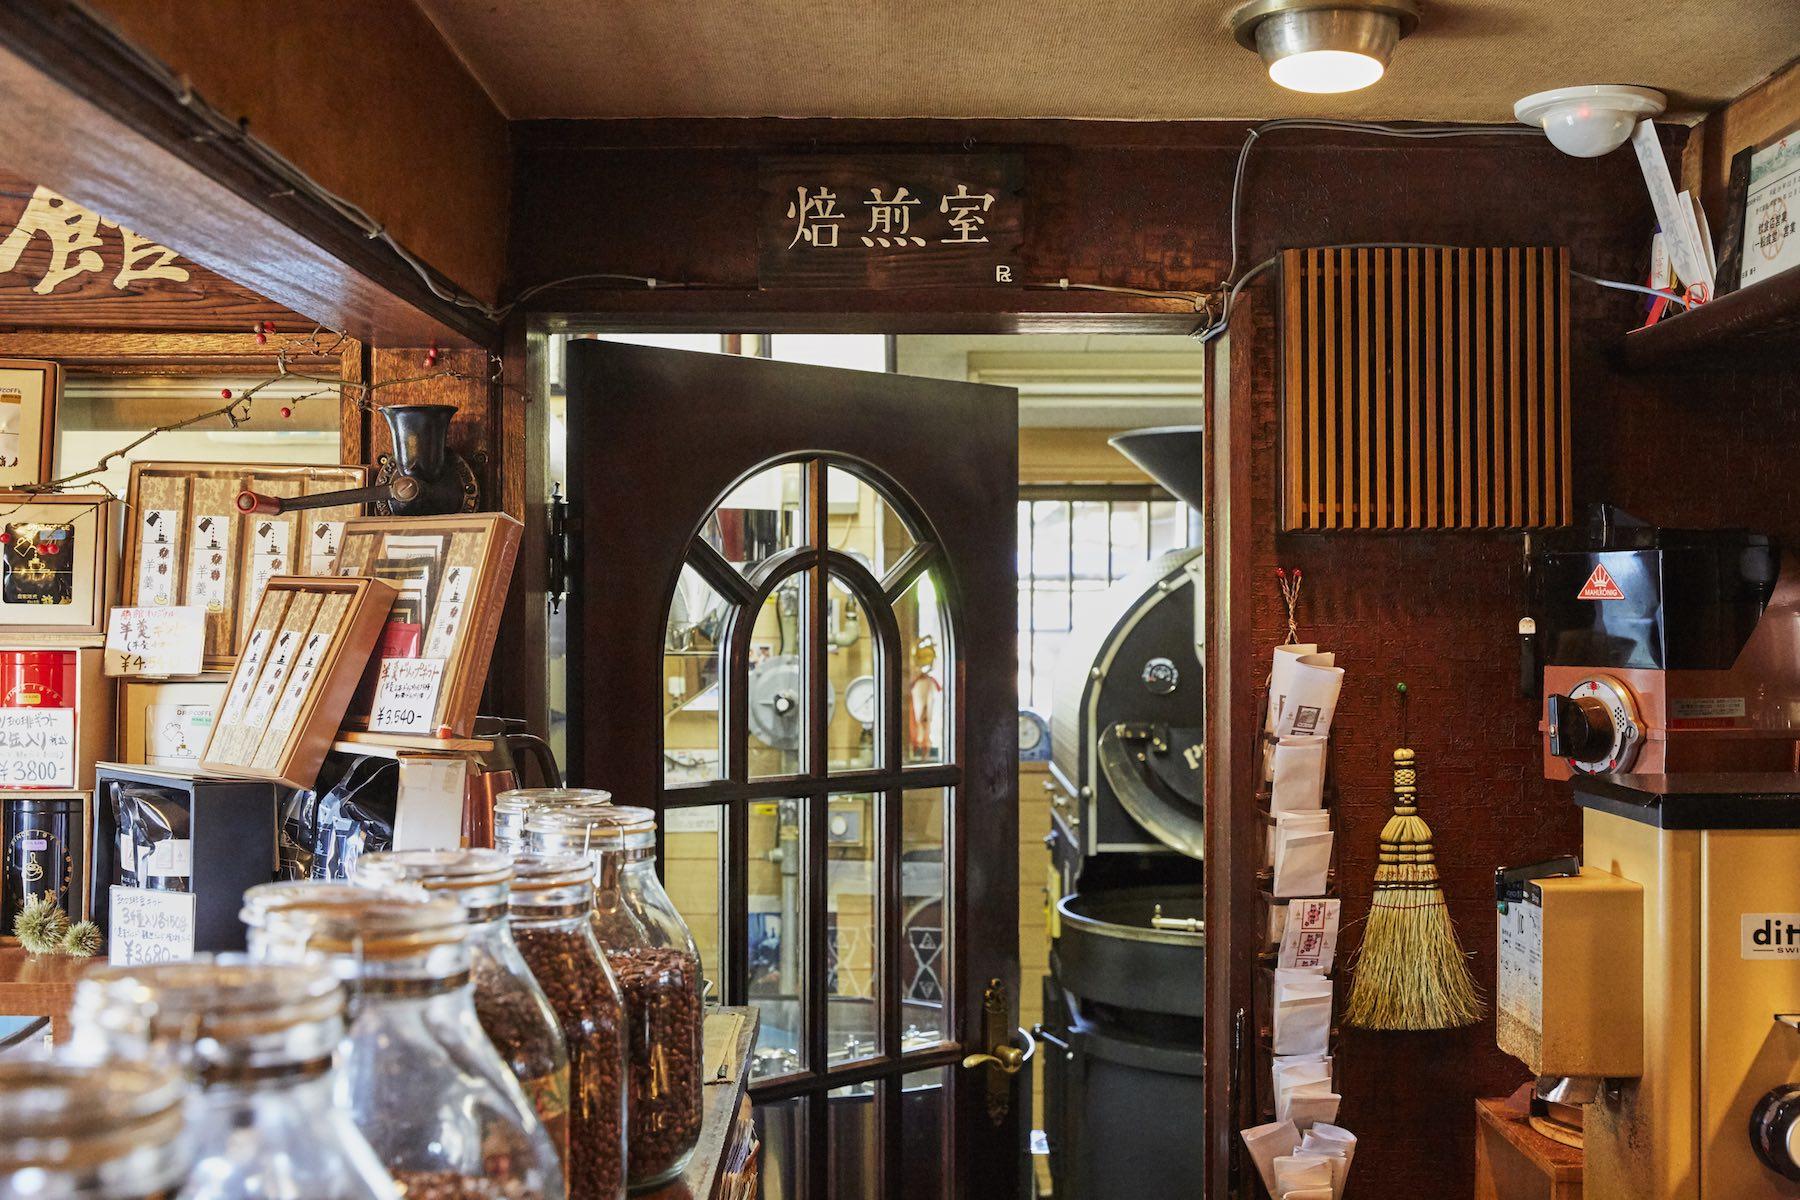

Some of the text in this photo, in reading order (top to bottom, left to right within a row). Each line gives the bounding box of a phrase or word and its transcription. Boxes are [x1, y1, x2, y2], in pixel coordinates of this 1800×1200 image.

[786, 184, 996, 250] 焙煎室
[1584, 587, 1617, 597] MAHLKÖNIG
[1753, 919, 1800, 945] dit
